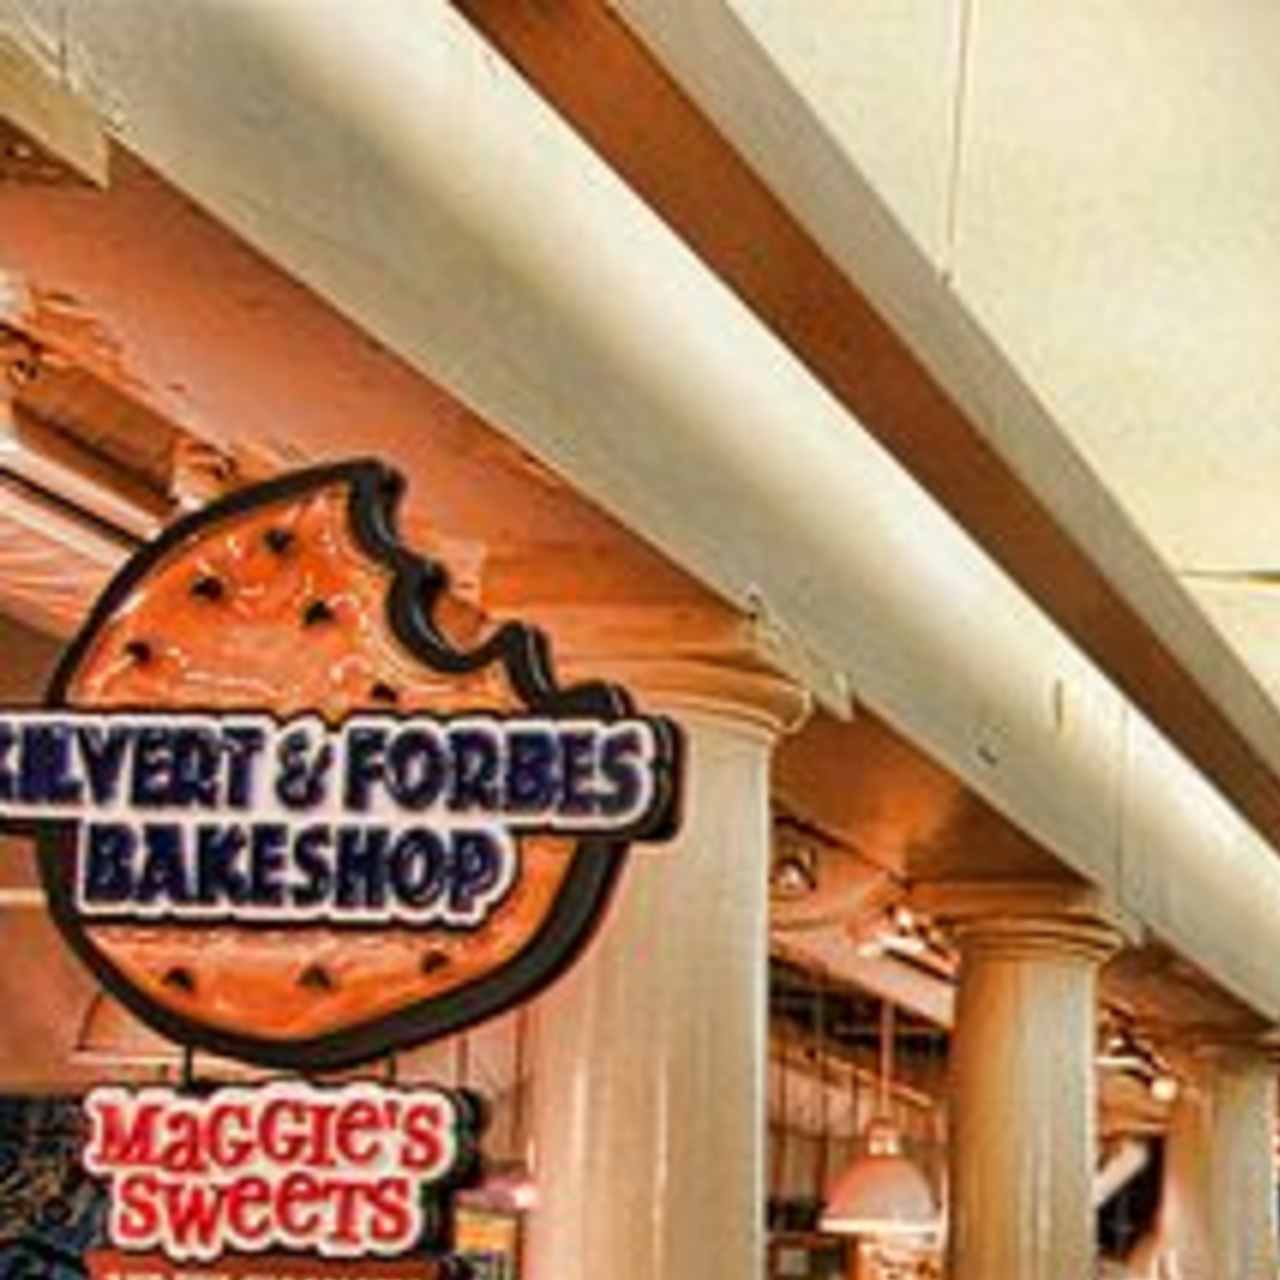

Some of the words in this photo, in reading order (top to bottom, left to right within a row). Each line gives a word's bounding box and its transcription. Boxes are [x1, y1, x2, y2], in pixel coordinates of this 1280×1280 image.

[276, 725, 333, 810] &
[342, 726, 646, 816] FORBES
[84, 821, 501, 910] BAKESHOP
